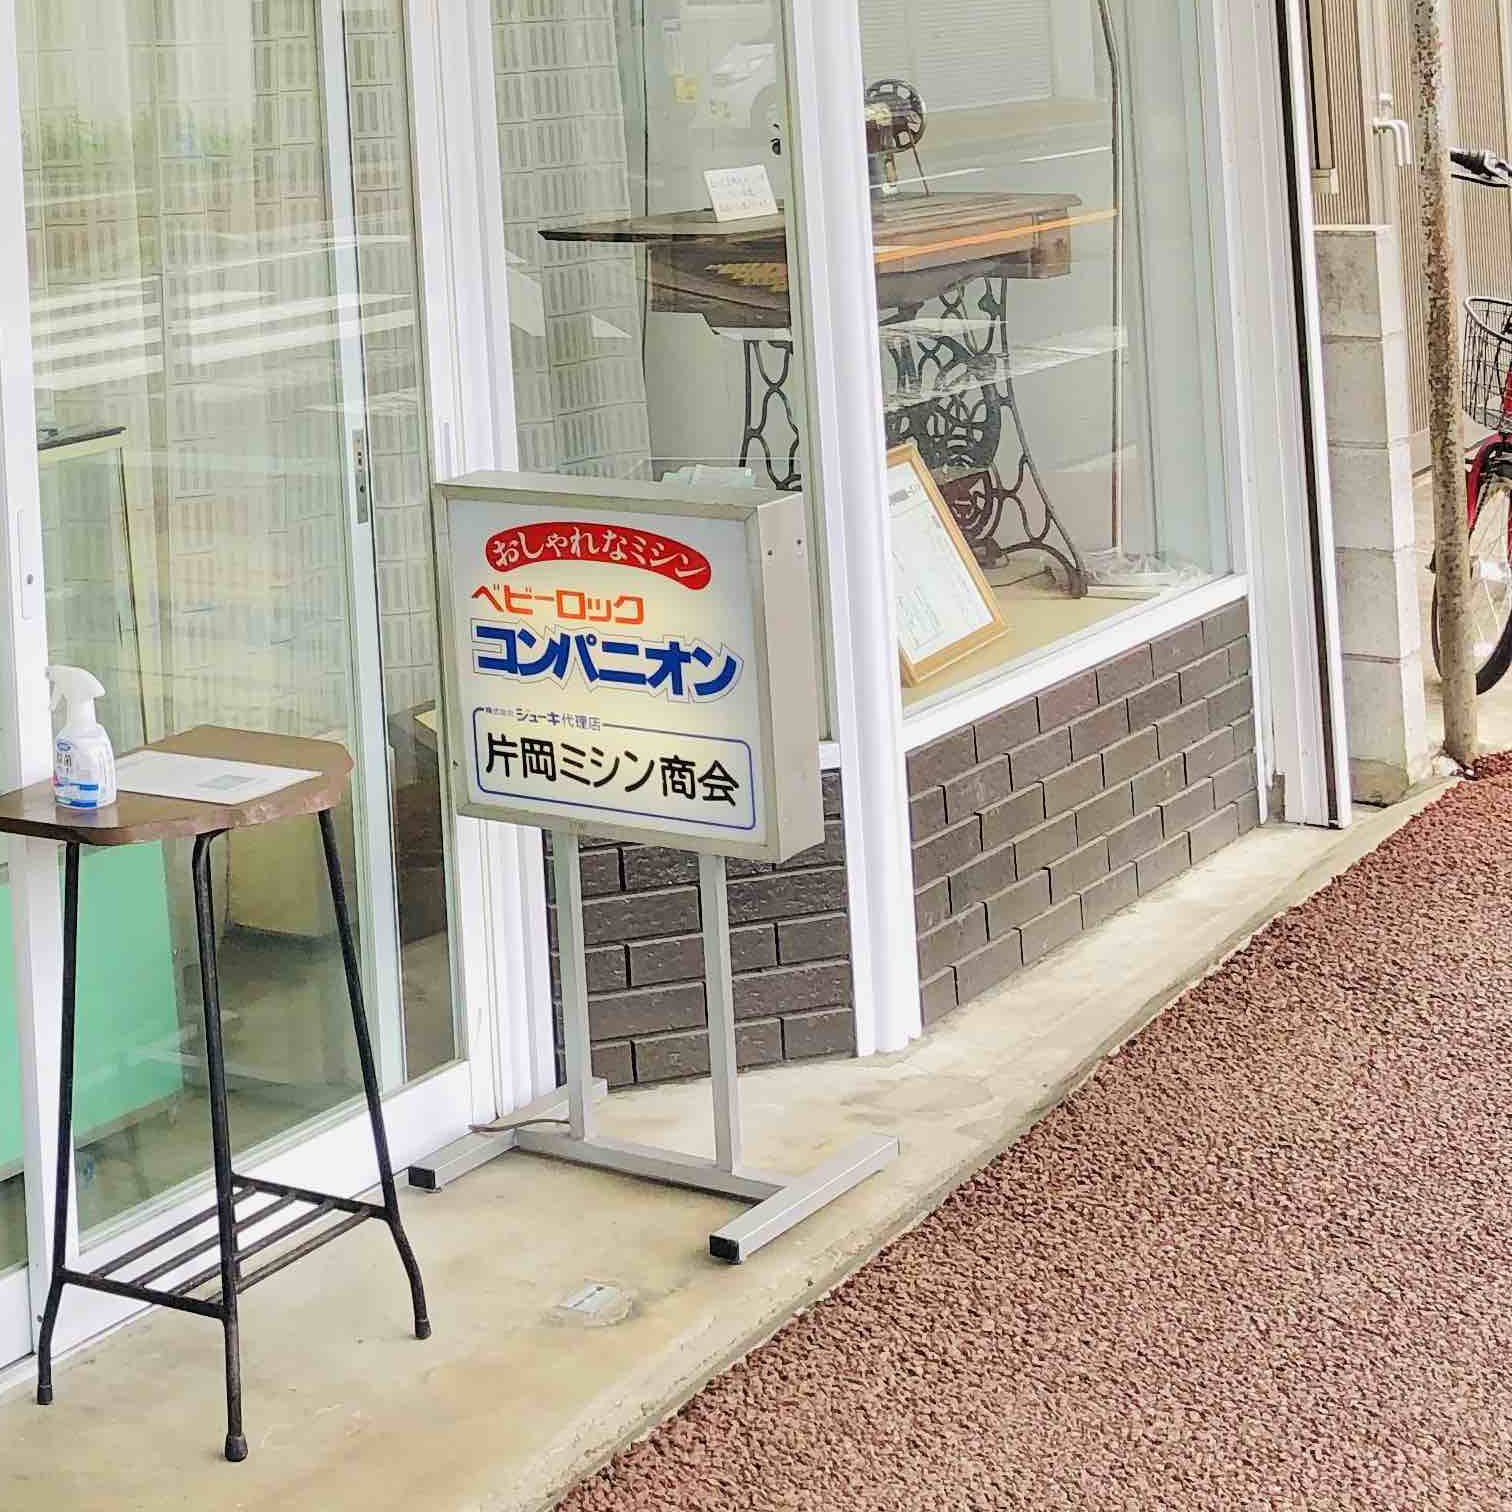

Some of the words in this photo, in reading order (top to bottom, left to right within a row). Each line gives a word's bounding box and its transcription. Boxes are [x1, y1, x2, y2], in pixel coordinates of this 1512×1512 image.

[493, 527, 708, 580] おしゃれなミシン
[471, 584, 646, 625] ベビーロック
[475, 624, 738, 696] コンパニオン
[485, 731, 741, 807] 片岡ミシン商会
